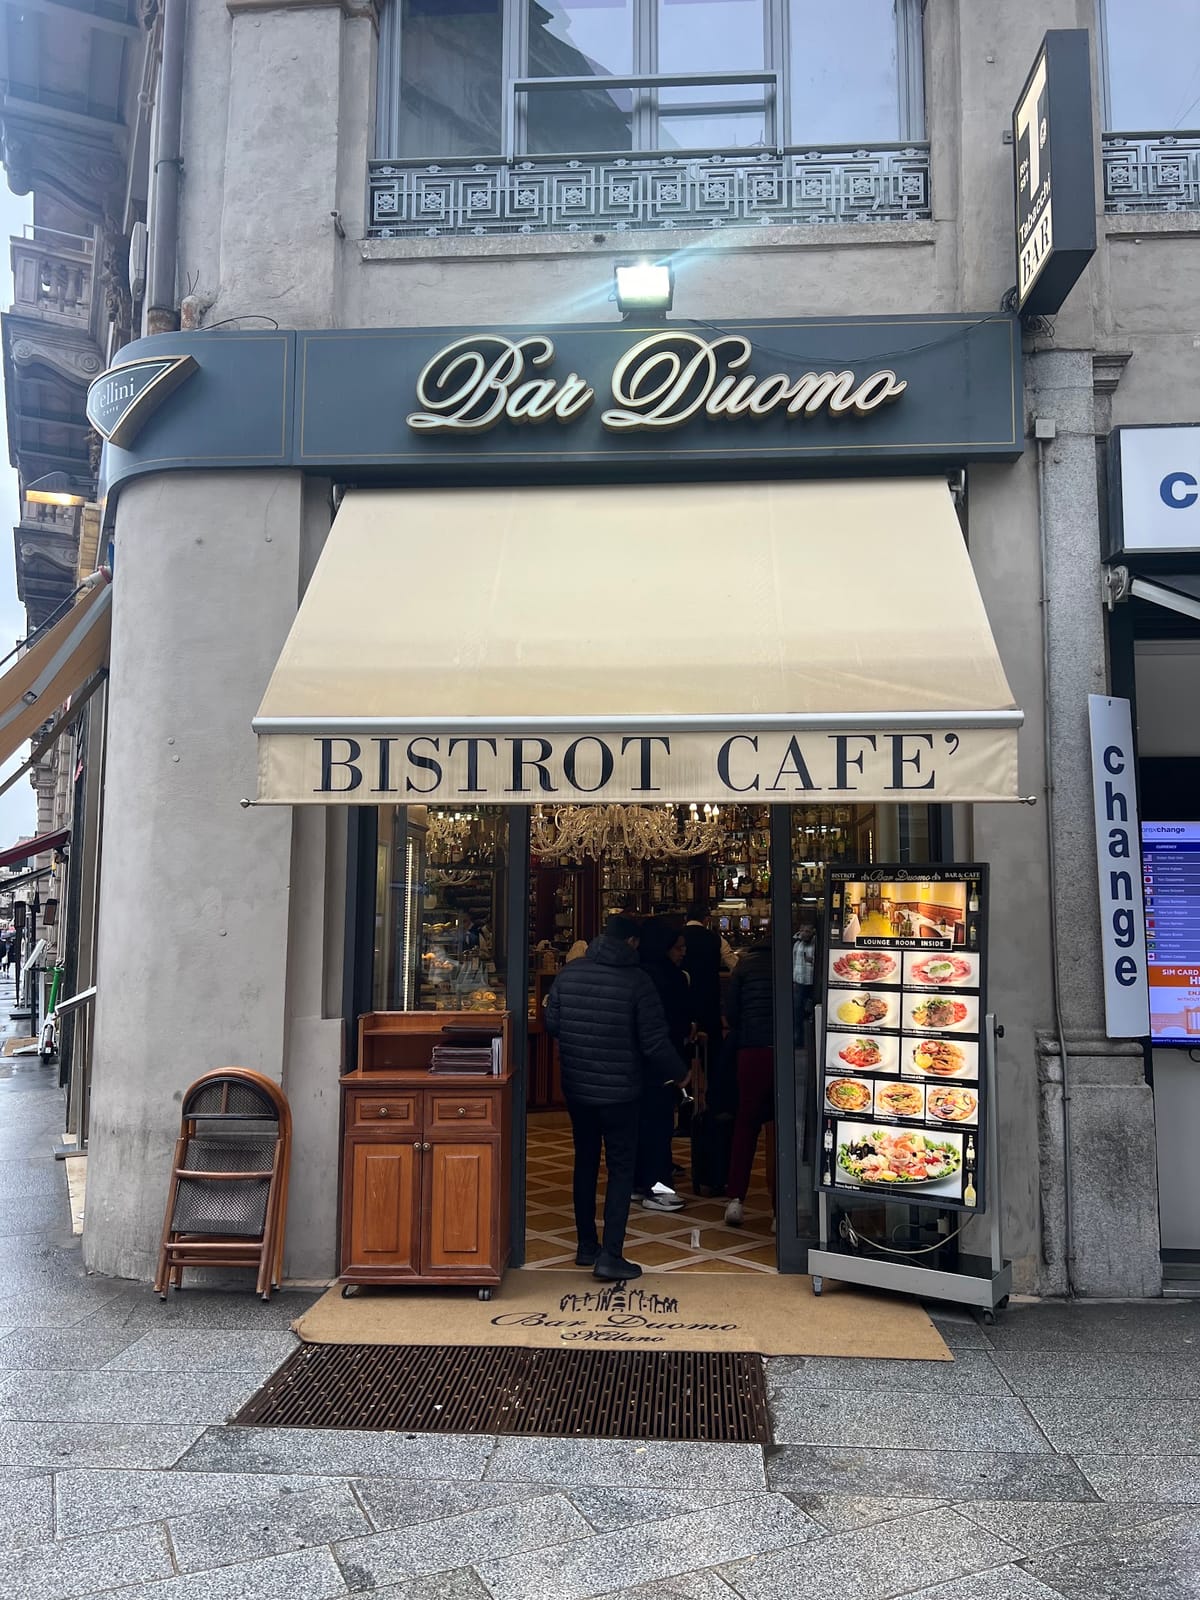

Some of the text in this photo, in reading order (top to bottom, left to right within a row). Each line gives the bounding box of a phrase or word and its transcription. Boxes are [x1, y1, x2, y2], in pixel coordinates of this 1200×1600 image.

[1019, 172, 1051, 244] Tabacchi
[1022, 215, 1051, 287] BAR
[92, 376, 135, 414] Cellini
[405, 331, 907, 430] Bar Duomo
[313, 736, 671, 793] BISTROT
[870, 869, 894, 882] Bar
[895, 869, 931, 882] Duomo
[1103, 744, 1138, 988] change
[863, 938, 891, 946] LOUNGE
[1162, 968, 1176, 976] SIM
[490, 1311, 742, 1331] Bar Duomo
[560, 1330, 667, 1343] Milano
